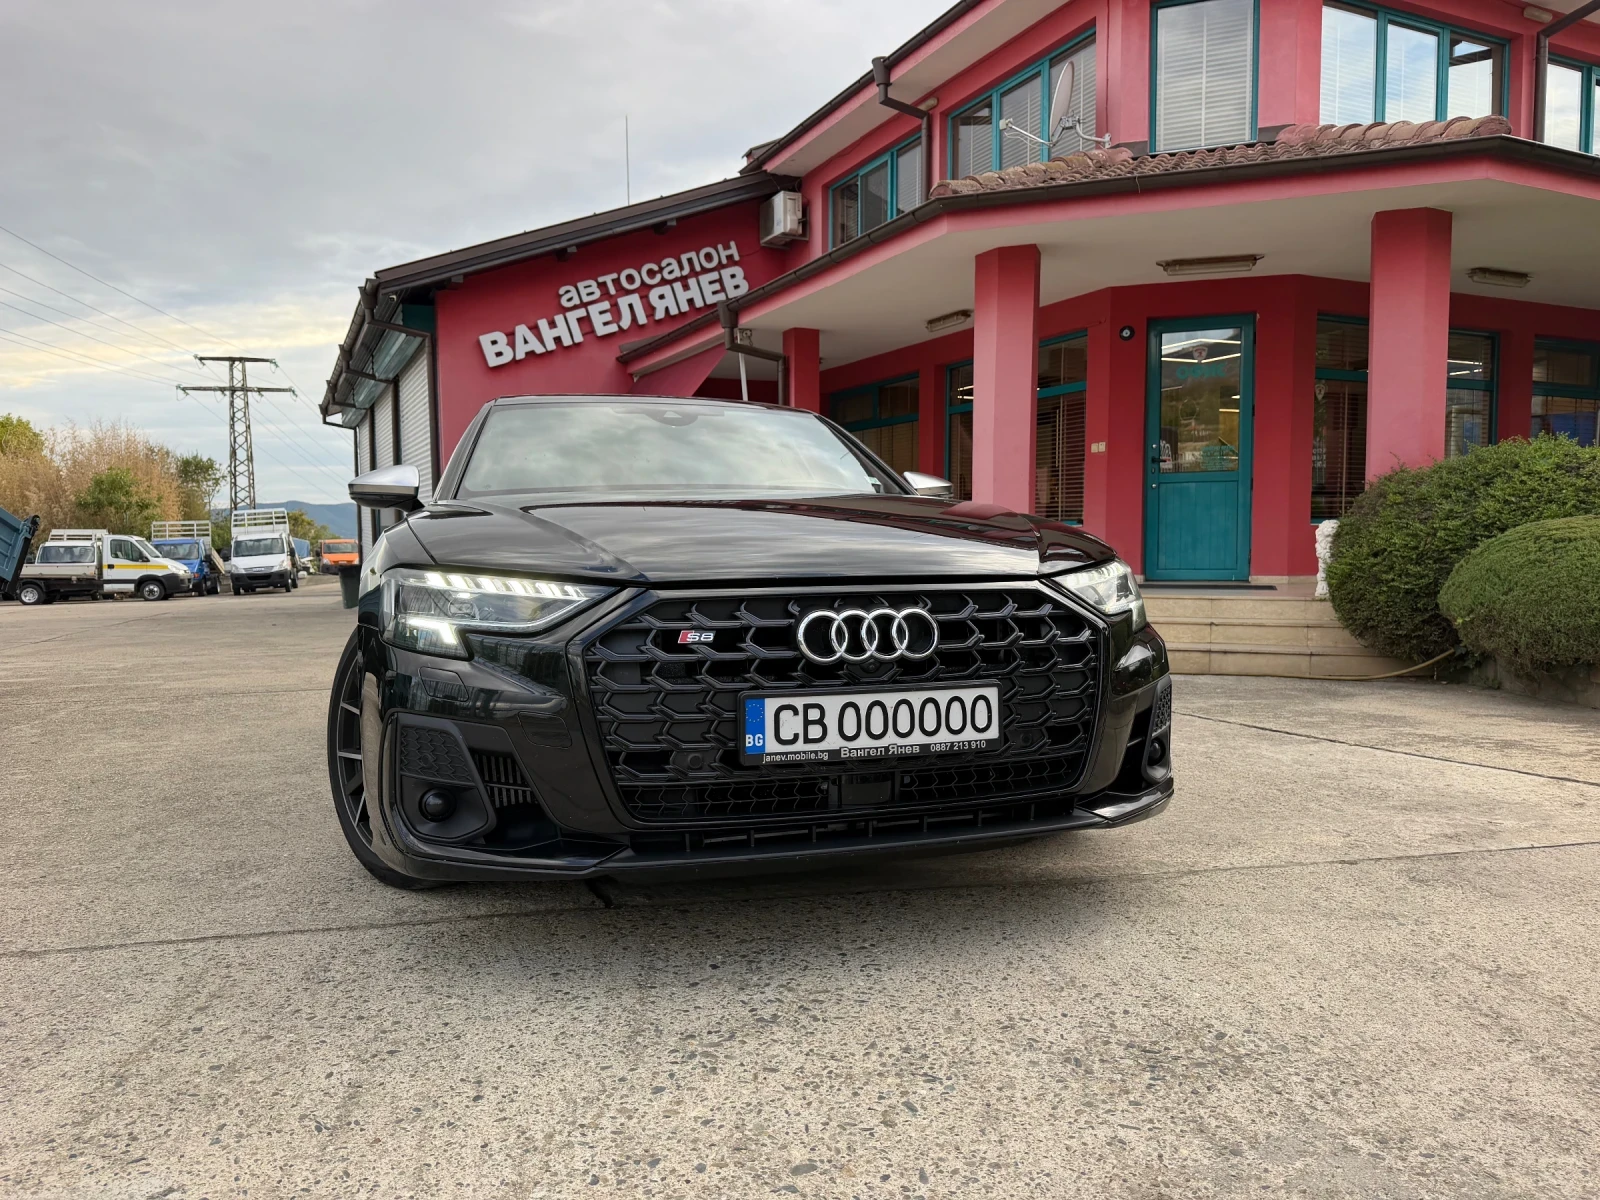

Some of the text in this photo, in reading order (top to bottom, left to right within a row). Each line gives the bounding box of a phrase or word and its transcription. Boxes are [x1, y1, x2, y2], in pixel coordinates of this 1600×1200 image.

[558, 240, 740, 308] автосалон
[478, 265, 750, 368] ВАНГЕЛ ЯНЕВ
[686, 632, 714, 642] S8
[745, 733, 764, 747] BG
[930, 740, 986, 752] 0887 213 910
[762, 750, 829, 764] janev.mobile.bg
[840, 744, 920, 758] Вангел Янев
